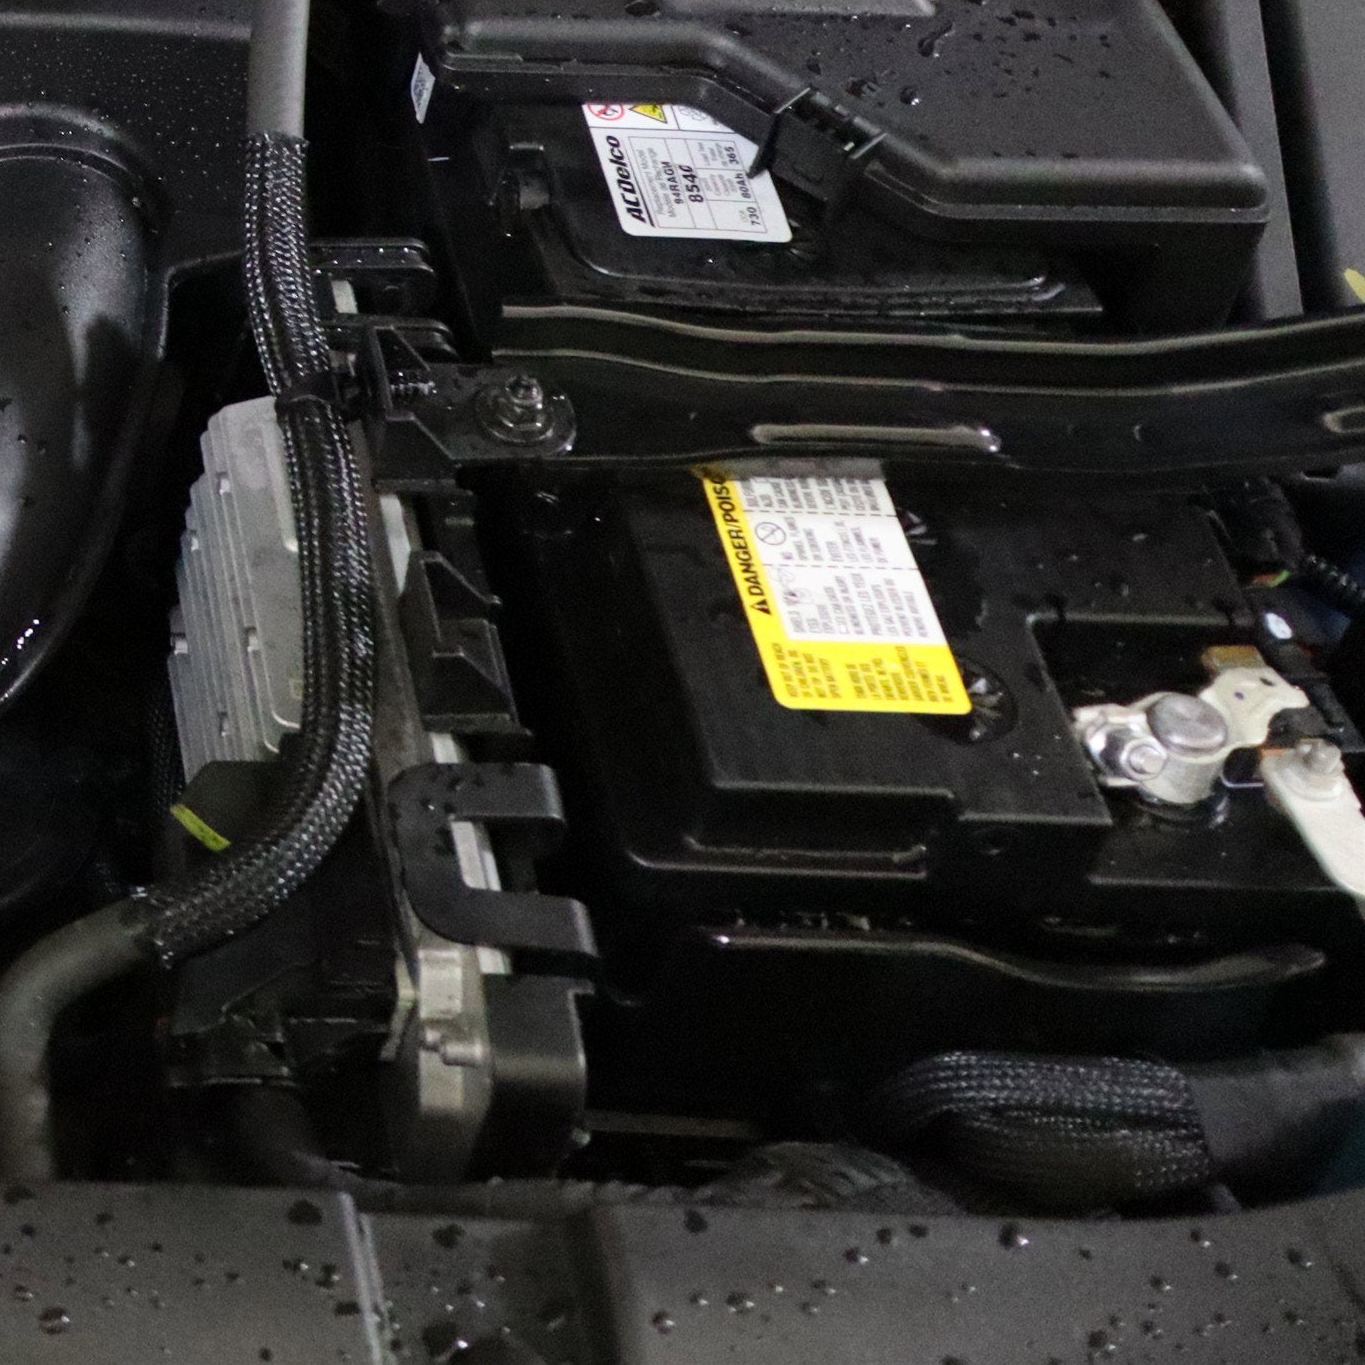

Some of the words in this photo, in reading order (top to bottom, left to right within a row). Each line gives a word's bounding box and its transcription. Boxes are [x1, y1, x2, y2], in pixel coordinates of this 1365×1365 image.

[724, 146, 739, 165] 365
[606, 135, 647, 223] ACDelco
[734, 172, 752, 199] 80Ah
[746, 206, 761, 226] 730
